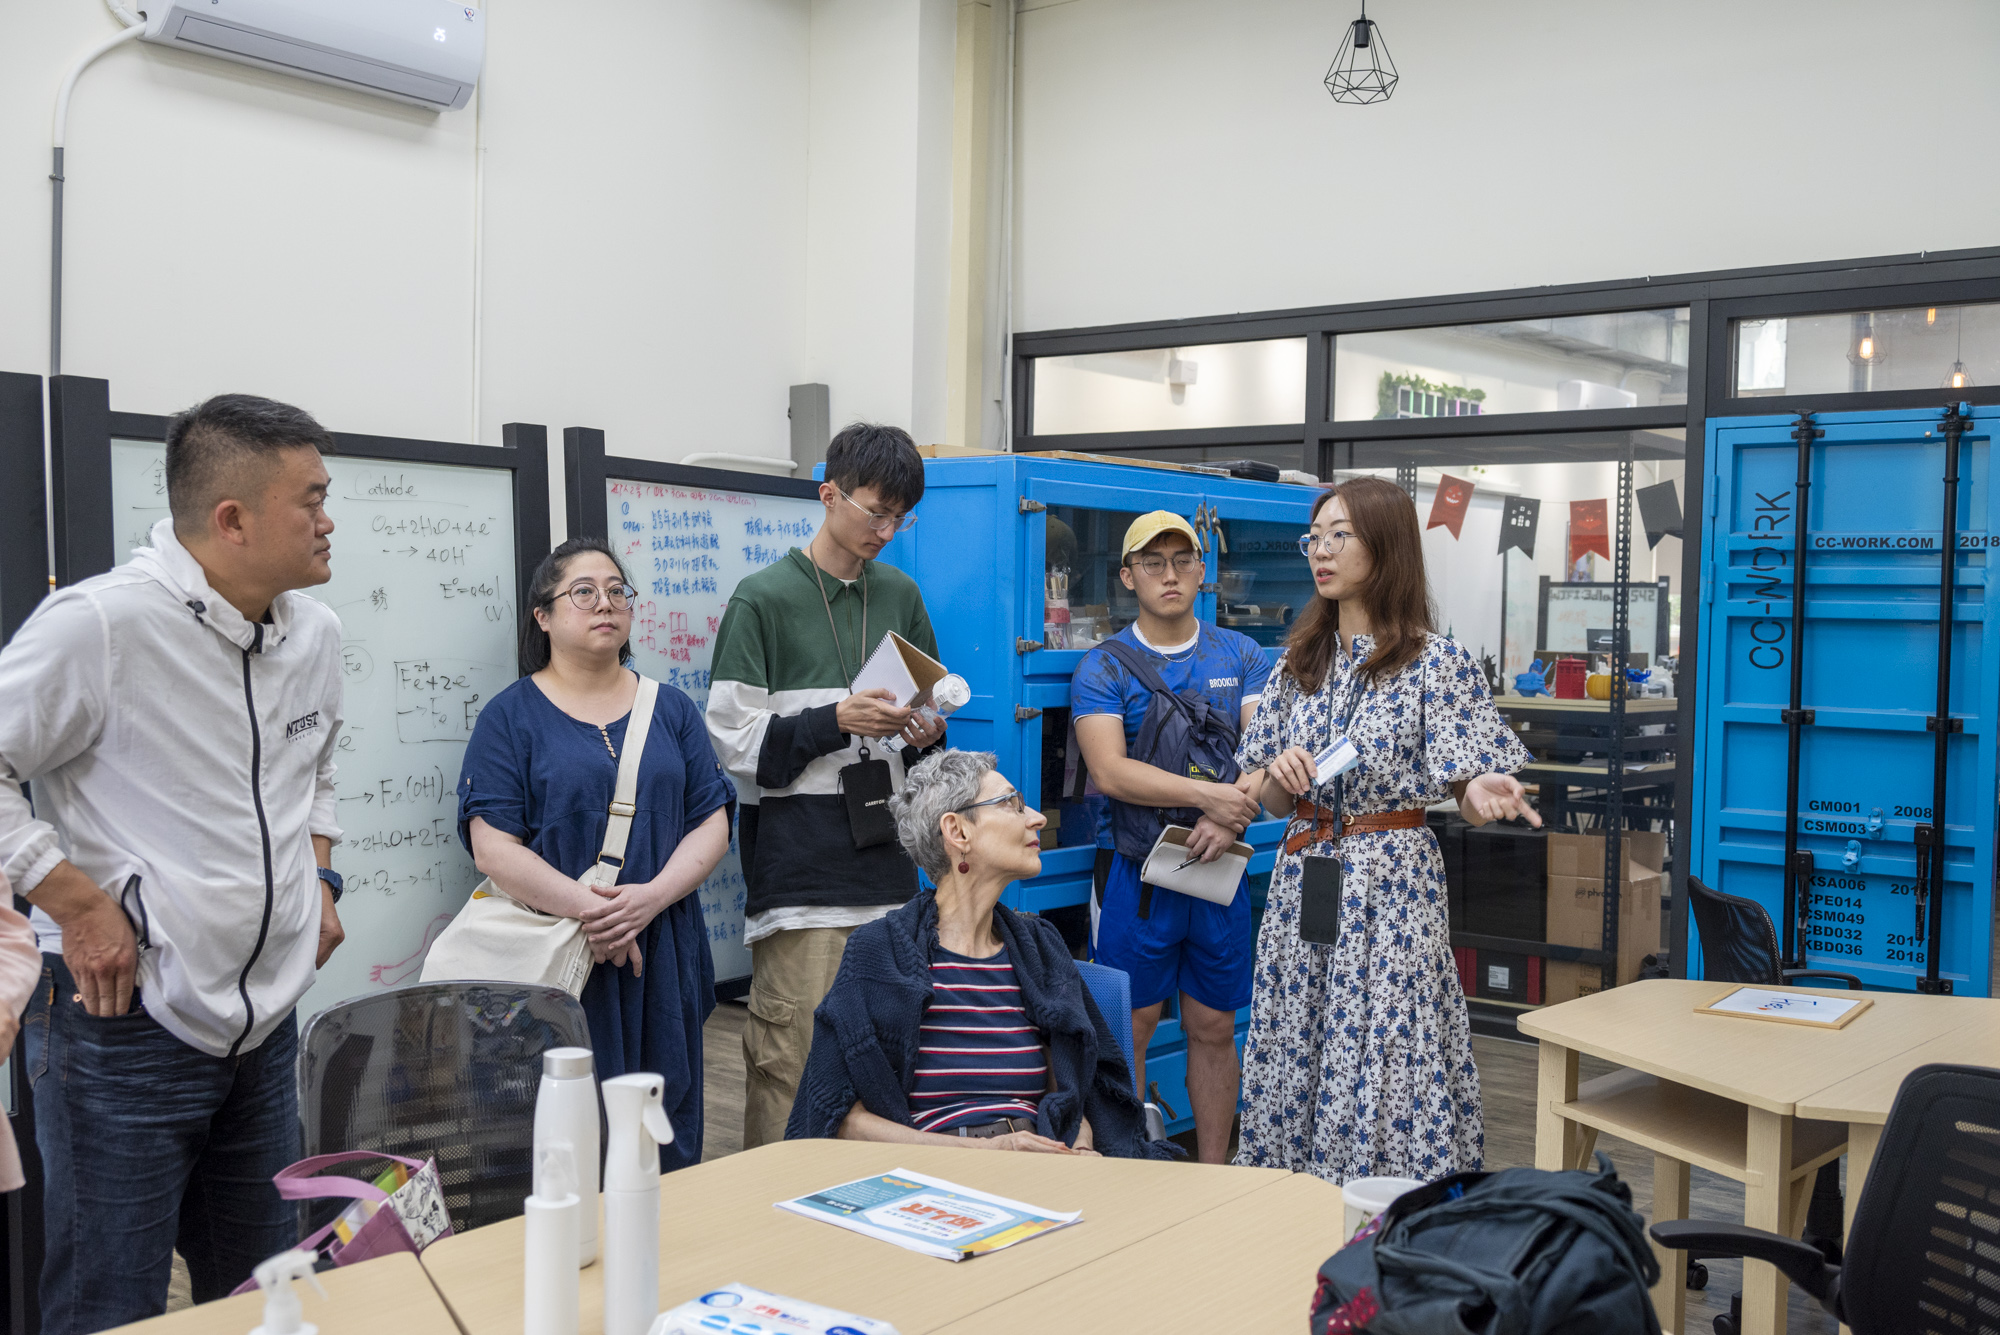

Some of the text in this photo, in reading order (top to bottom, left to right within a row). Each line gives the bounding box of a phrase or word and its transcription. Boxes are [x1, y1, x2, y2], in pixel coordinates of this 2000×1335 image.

[355, 472, 418, 496] Cathode
[1815, 535, 2000, 549] CC-WORK.COM 2018
[1746, 491, 1790, 670] CC-WORK
[1208, 677, 1239, 689] BROOKLYN
[286, 710, 319, 738] NTUST
[1809, 800, 1933, 818] GM001 2008
[1804, 820, 1867, 835] CSM003
[1886, 948, 1925, 963] 2018
